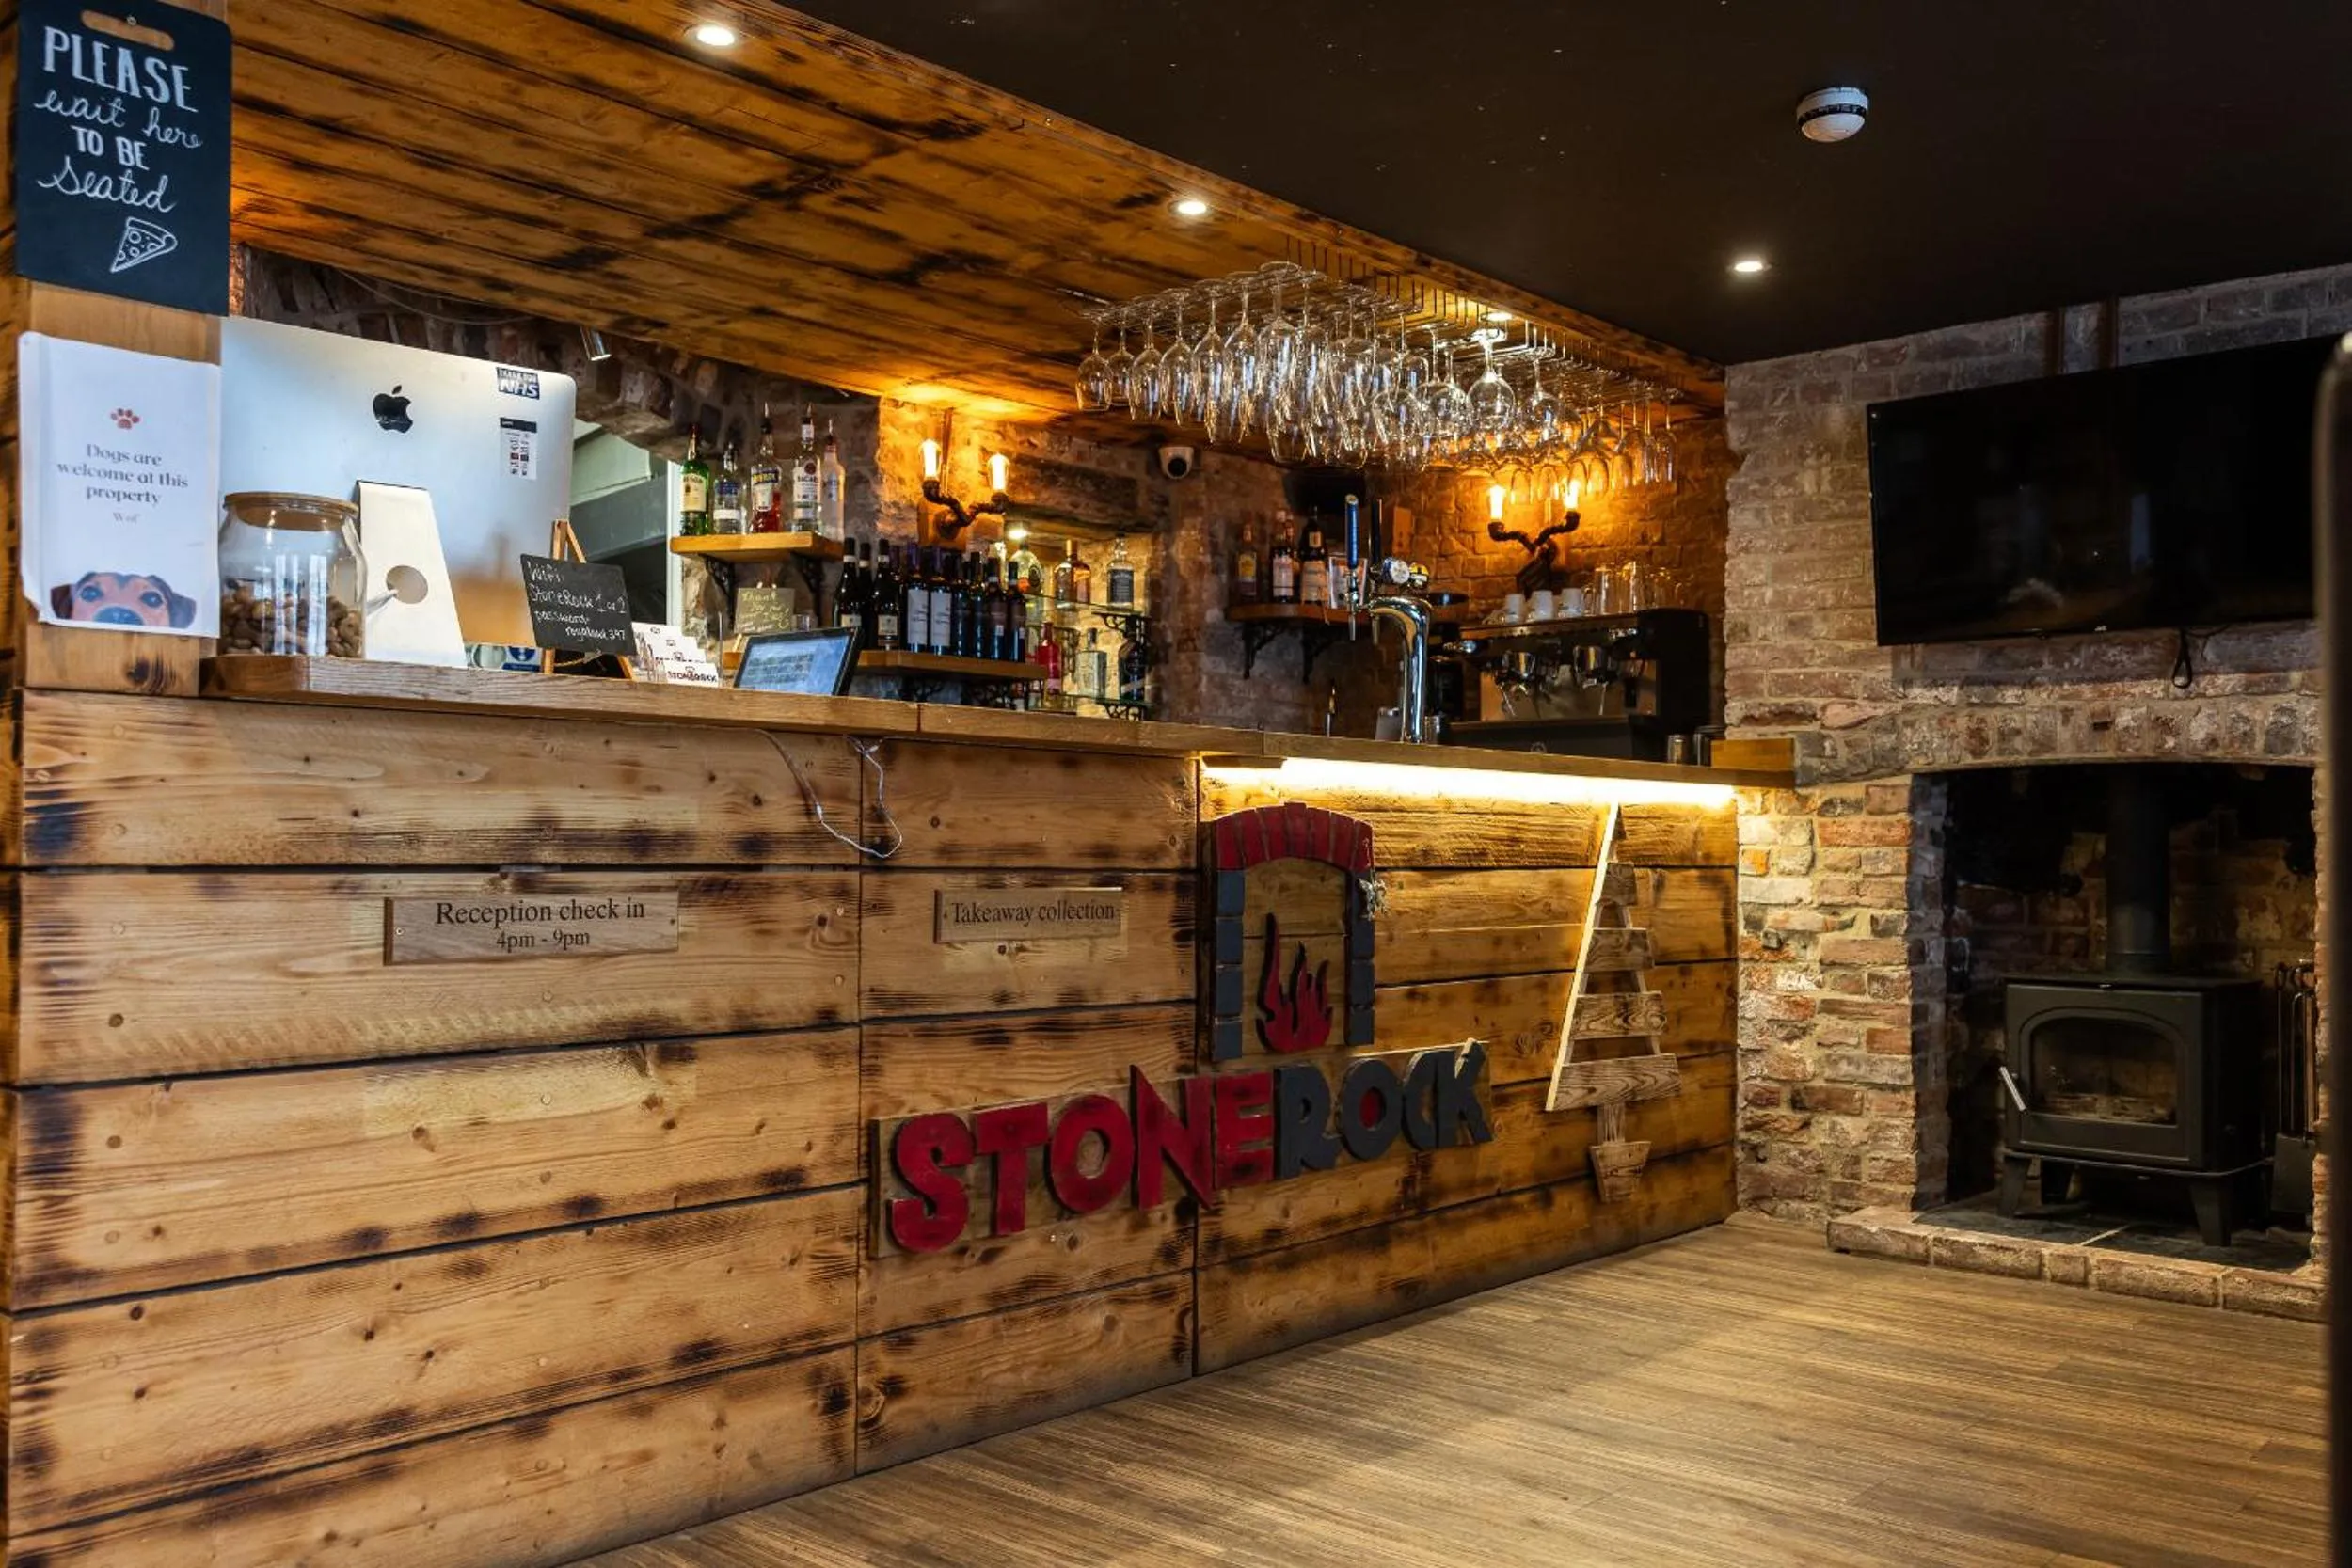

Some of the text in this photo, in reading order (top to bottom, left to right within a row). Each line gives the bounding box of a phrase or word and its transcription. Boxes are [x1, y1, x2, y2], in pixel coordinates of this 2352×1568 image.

[43, 26, 199, 112] PLEASE
[34, 90, 203, 149] wait here
[71, 125, 150, 170] TO BE
[499, 378, 538, 397] NHS
[87, 443, 162, 466] Dogs are
[57, 463, 188, 488] welcome at this
[87, 486, 161, 508] property
[436, 897, 645, 928] Reception check in
[952, 898, 1115, 927] Takeaway collection
[496, 931, 535, 953] 4pm
[552, 929, 591, 951] 9pm
